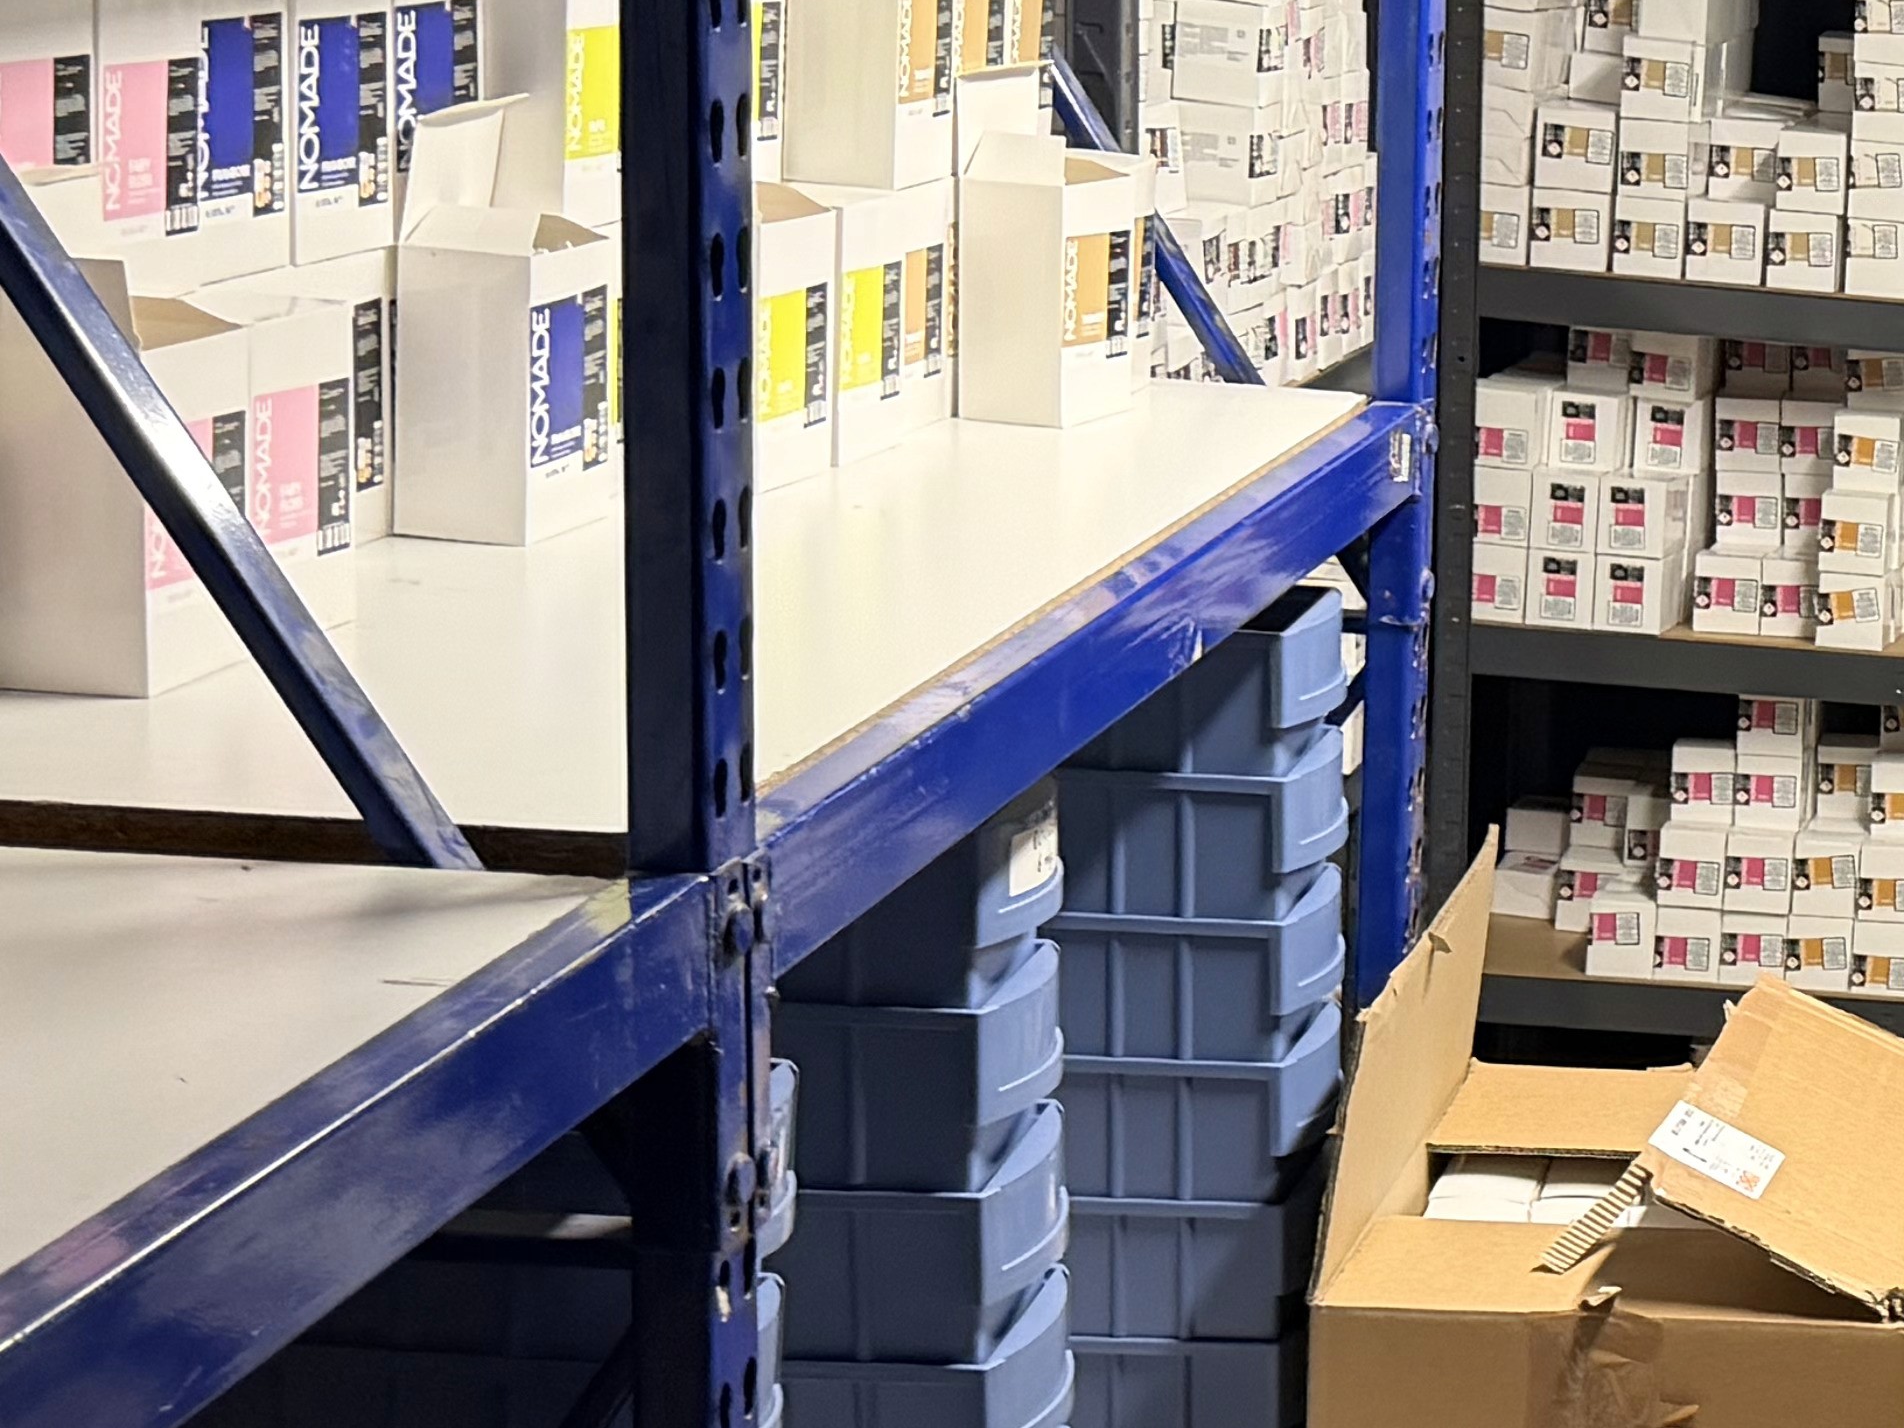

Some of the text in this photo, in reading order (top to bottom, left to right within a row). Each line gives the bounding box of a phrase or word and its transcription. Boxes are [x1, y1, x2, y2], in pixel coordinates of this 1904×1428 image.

[104, 70, 123, 211] NOMADE
[299, 25, 320, 191] NOMADE
[529, 307, 551, 466] NOMADE
